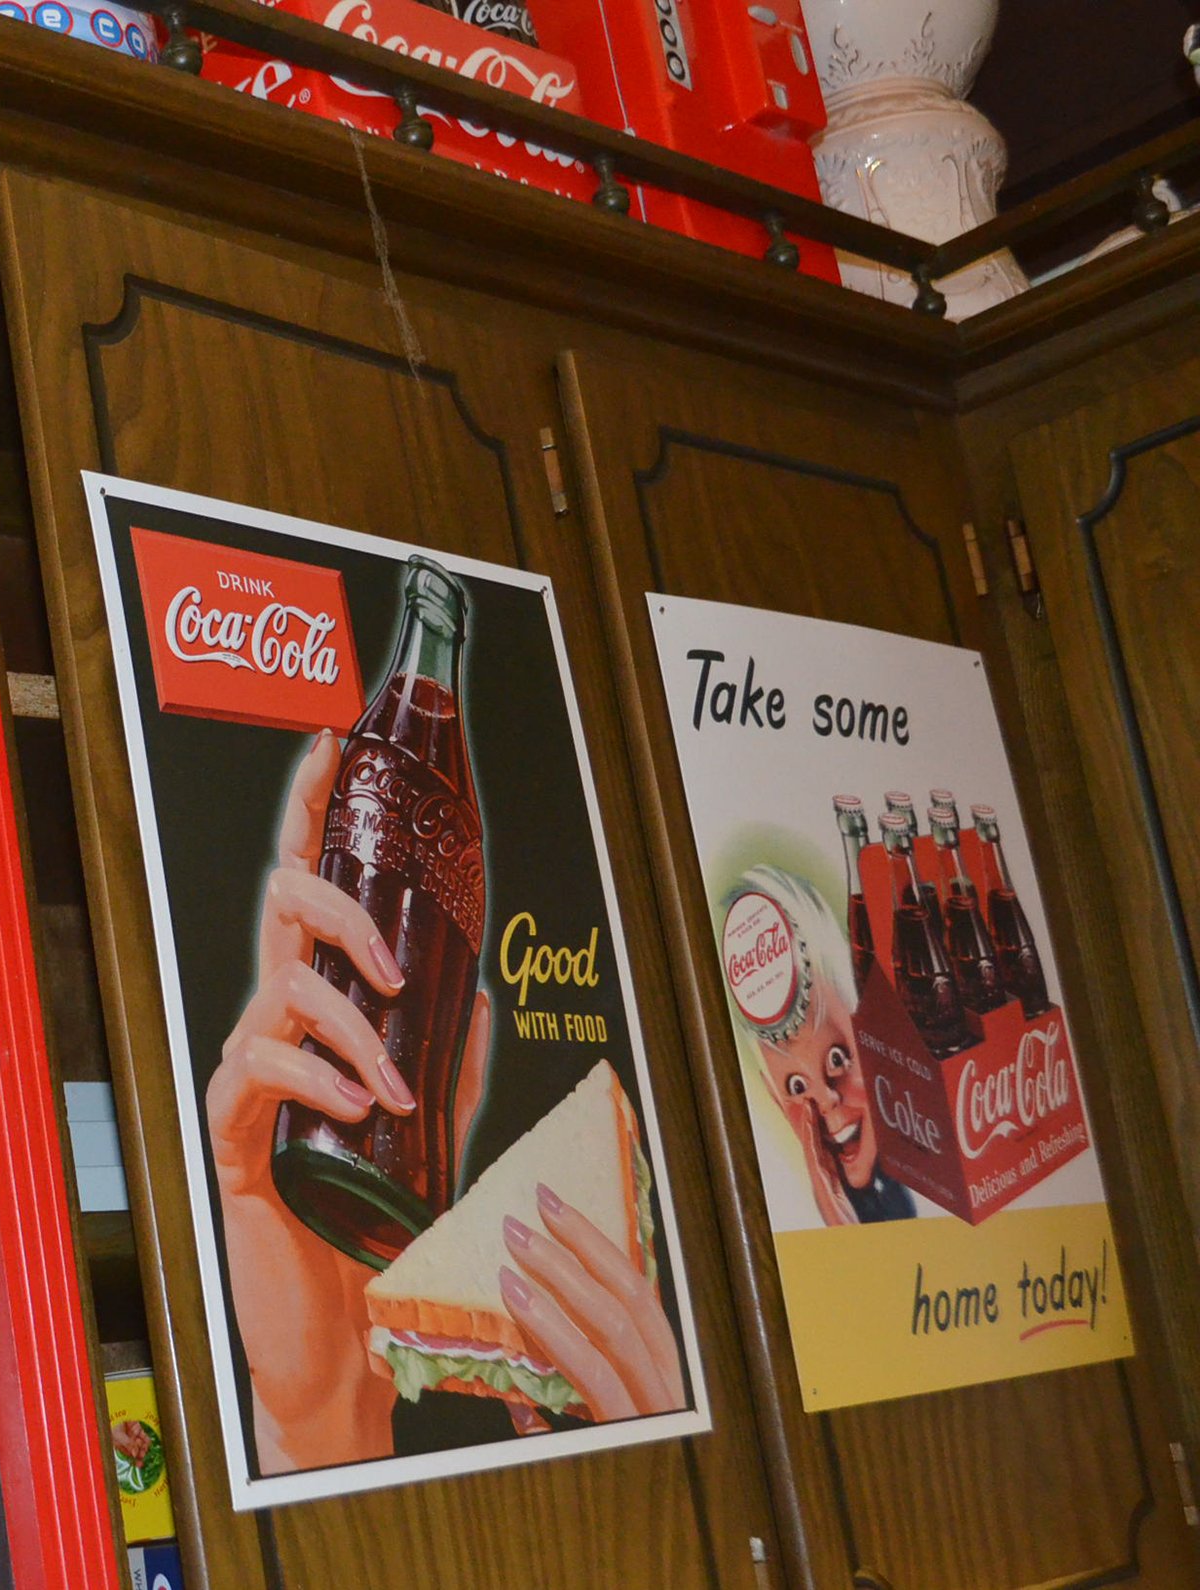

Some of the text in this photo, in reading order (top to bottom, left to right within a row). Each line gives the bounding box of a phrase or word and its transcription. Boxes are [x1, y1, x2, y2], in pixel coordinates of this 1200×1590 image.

[216, 570, 276, 598] DRINK
[164, 585, 340, 685] Coca-Cola
[685, 648, 911, 746] Take some
[500, 911, 600, 1007] Good
[729, 921, 788, 987] Coca-Cola
[513, 1009, 608, 1043] WITH FOOD
[875, 1075, 942, 1155] Coke
[956, 1021, 1069, 1159] Coca-Cola
[968, 1166, 1018, 1209] Delicious
[1019, 1147, 1039, 1177] and
[1039, 1122, 1087, 1164] Refreshing
[911, 1238, 1108, 1335] home today!
